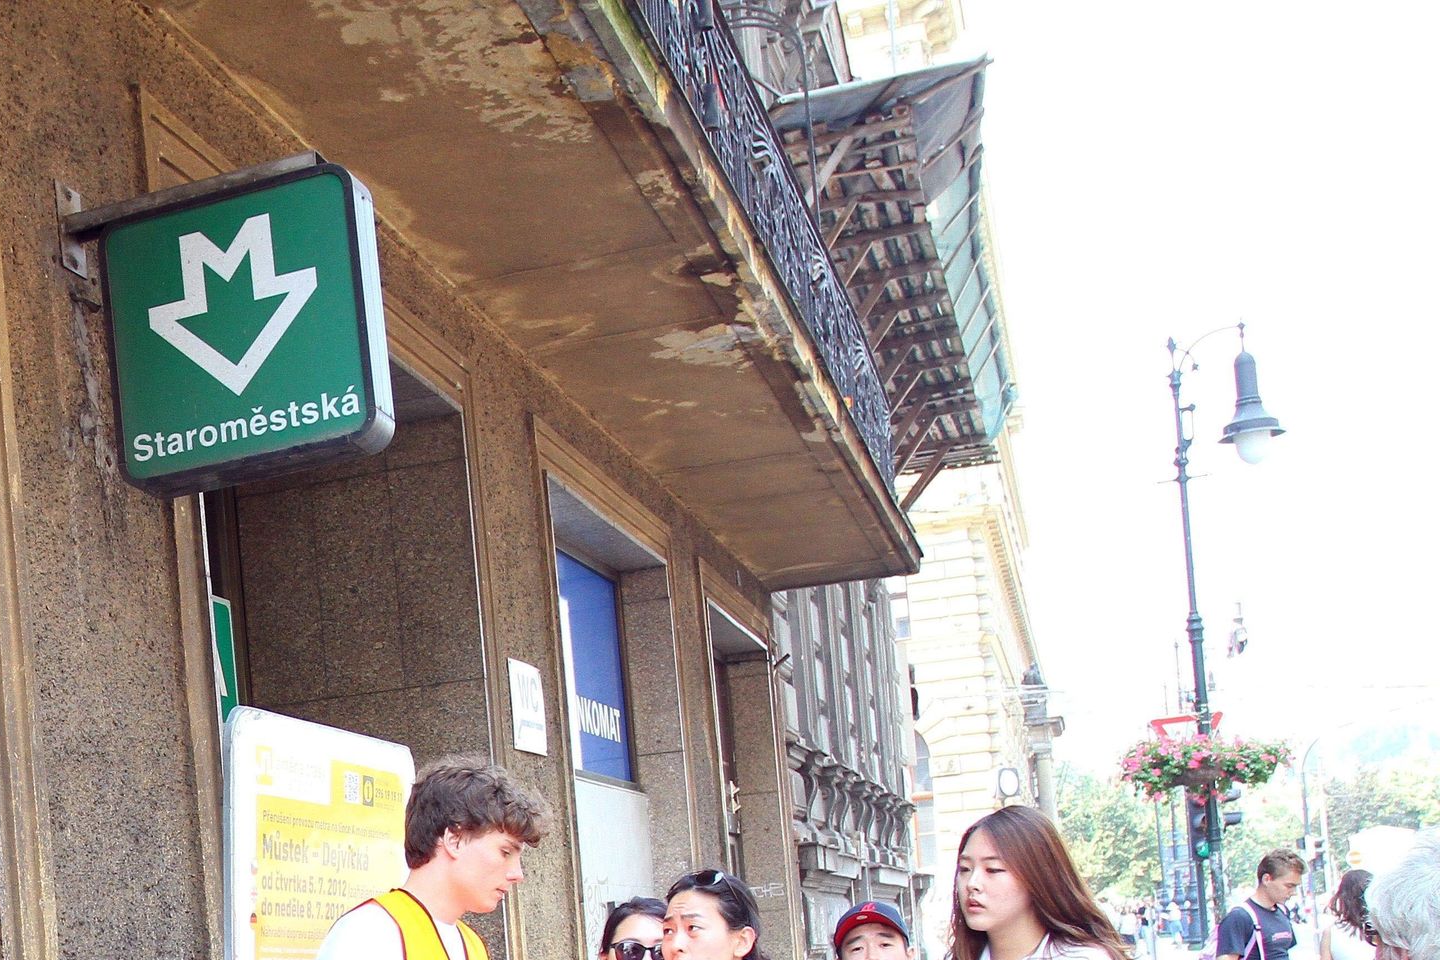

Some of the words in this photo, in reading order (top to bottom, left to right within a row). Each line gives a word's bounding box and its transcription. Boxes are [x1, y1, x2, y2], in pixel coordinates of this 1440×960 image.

[133, 385, 360, 462] Staroměstská
[516, 672, 539, 712] WC
[262, 831, 309, 864] Můstek
[323, 842, 368, 873] Dejvická
[261, 873, 273, 890] od
[275, 871, 307, 894] čtvrtka
[308, 876, 317, 895] 5.
[318, 878, 326, 895] 7.
[327, 878, 348, 897] 2012
[261, 897, 273, 916] do
[274, 898, 305, 919] neděle
[306, 900, 315, 920] 8.
[316, 902, 324, 920] 7.
